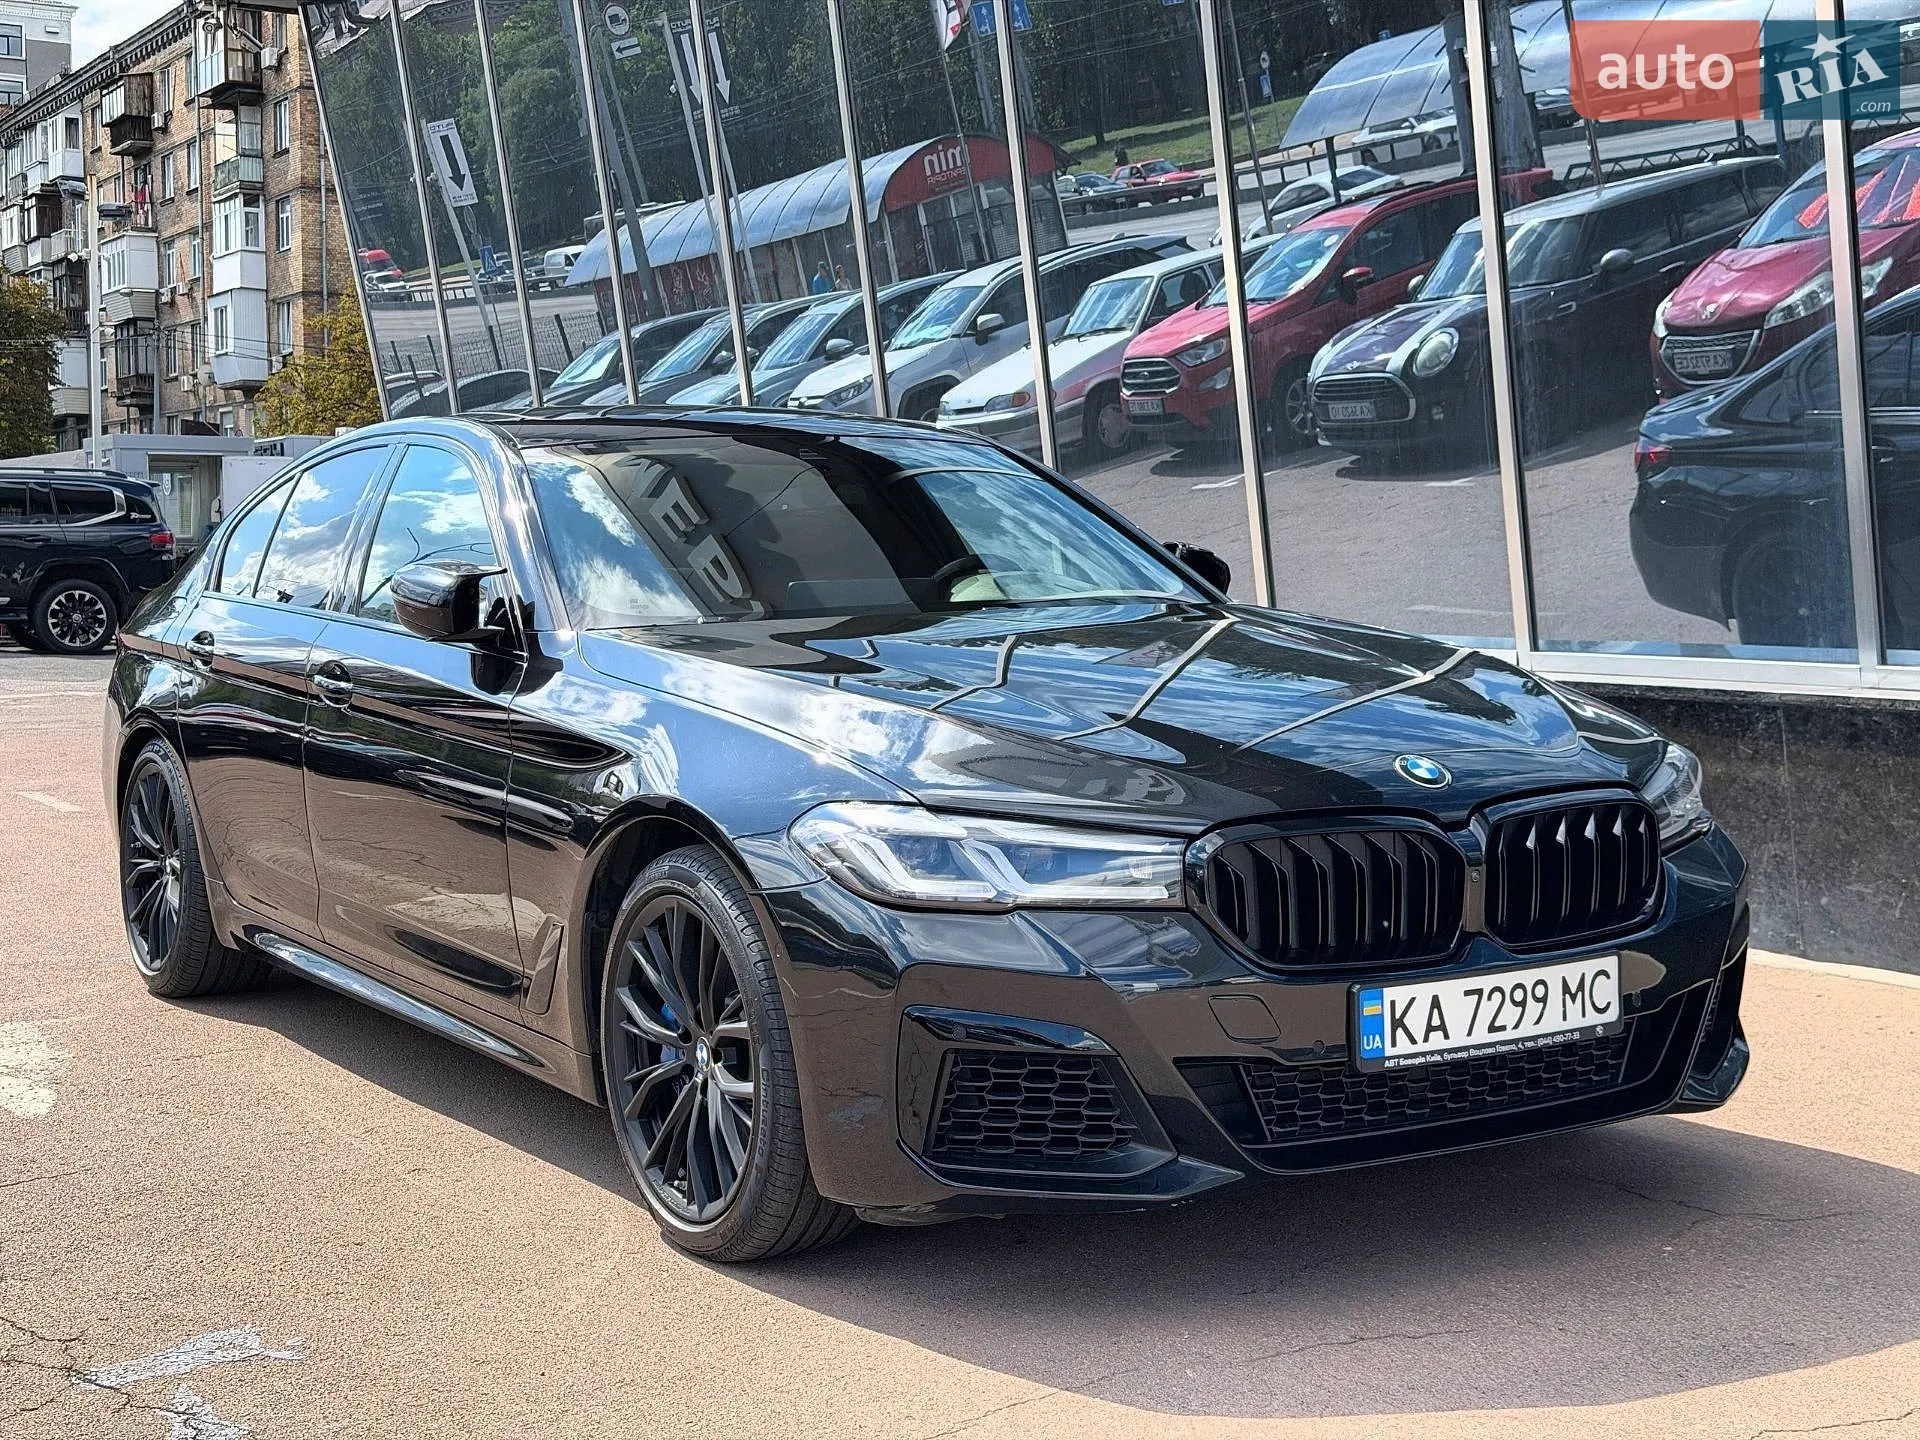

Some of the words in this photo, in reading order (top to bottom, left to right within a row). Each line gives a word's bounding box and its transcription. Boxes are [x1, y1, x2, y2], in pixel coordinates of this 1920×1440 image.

[1389, 994, 1451, 1048] KA
[1463, 978, 1549, 1038] 7299
[1561, 969, 1612, 1022] MC
[1363, 1035, 1383, 1050] UA
